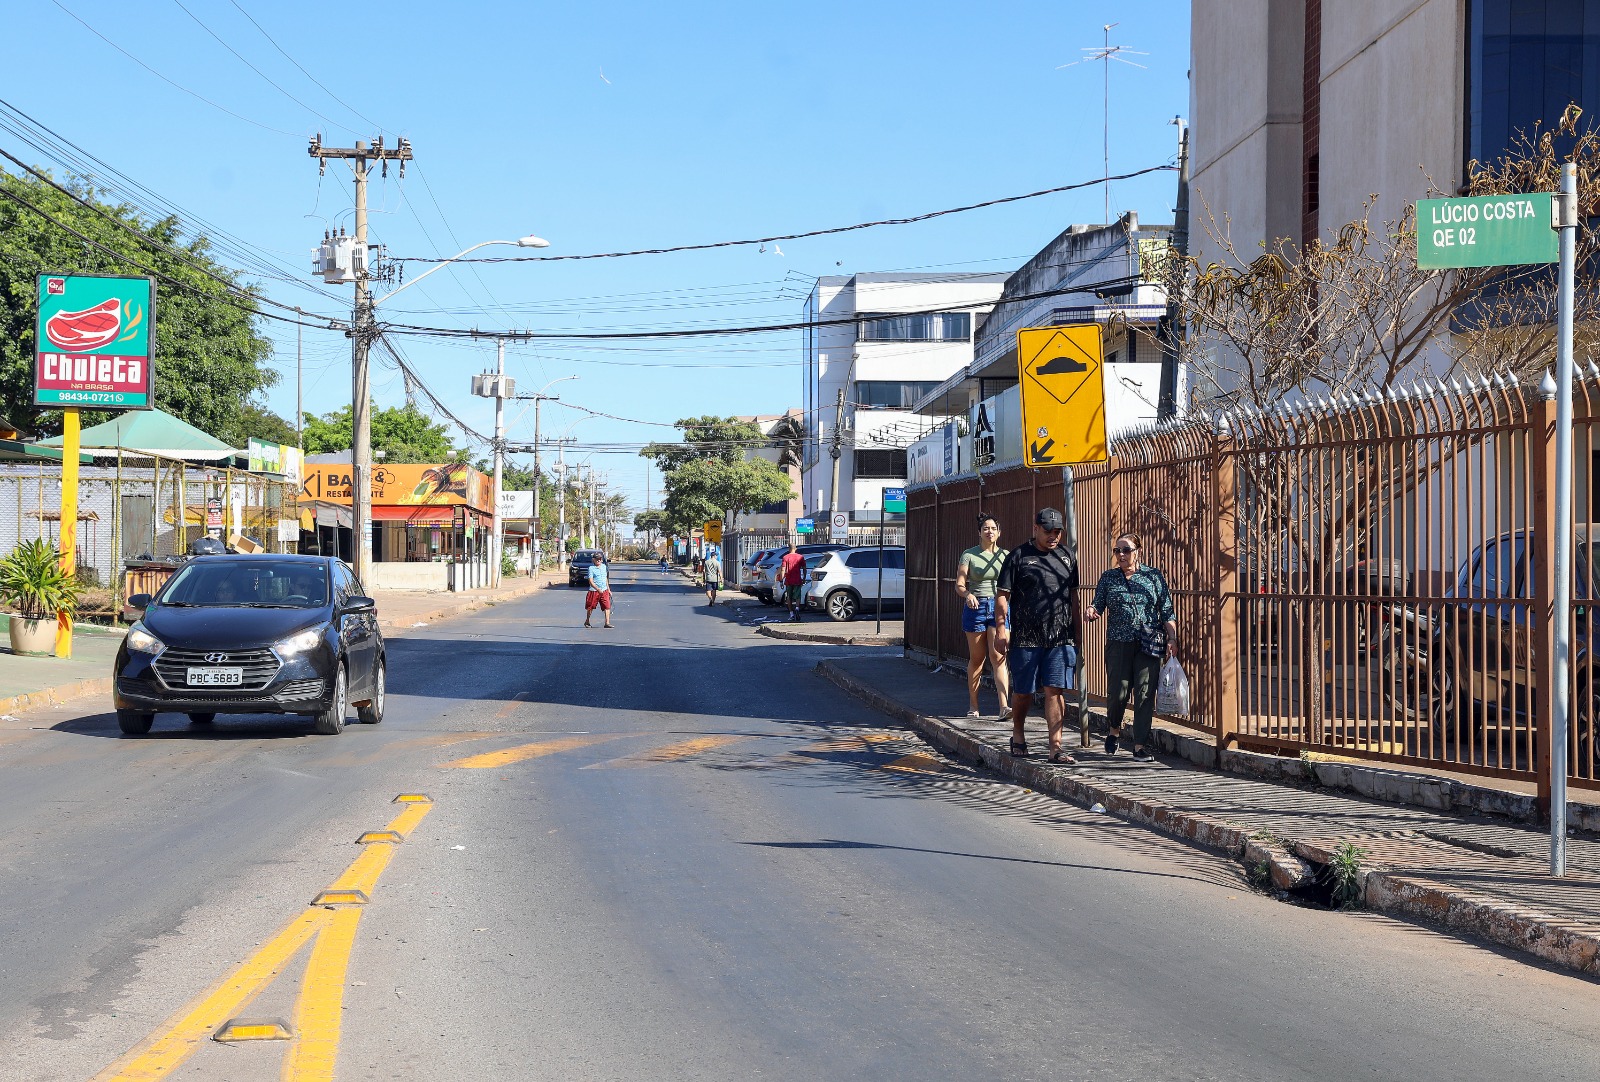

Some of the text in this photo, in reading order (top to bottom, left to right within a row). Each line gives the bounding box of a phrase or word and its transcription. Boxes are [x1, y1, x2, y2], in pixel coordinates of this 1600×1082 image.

[1432, 200, 1536, 225] LÚCIO COSTA
[1433, 227, 1476, 248] QE 02
[43, 353, 141, 384] Chuleta
[85, 383, 114, 391] BRASA
[58, 392, 114, 402] 98434-0721
[374, 471, 385, 483] &
[326, 490, 384, 498] RESTANTE
